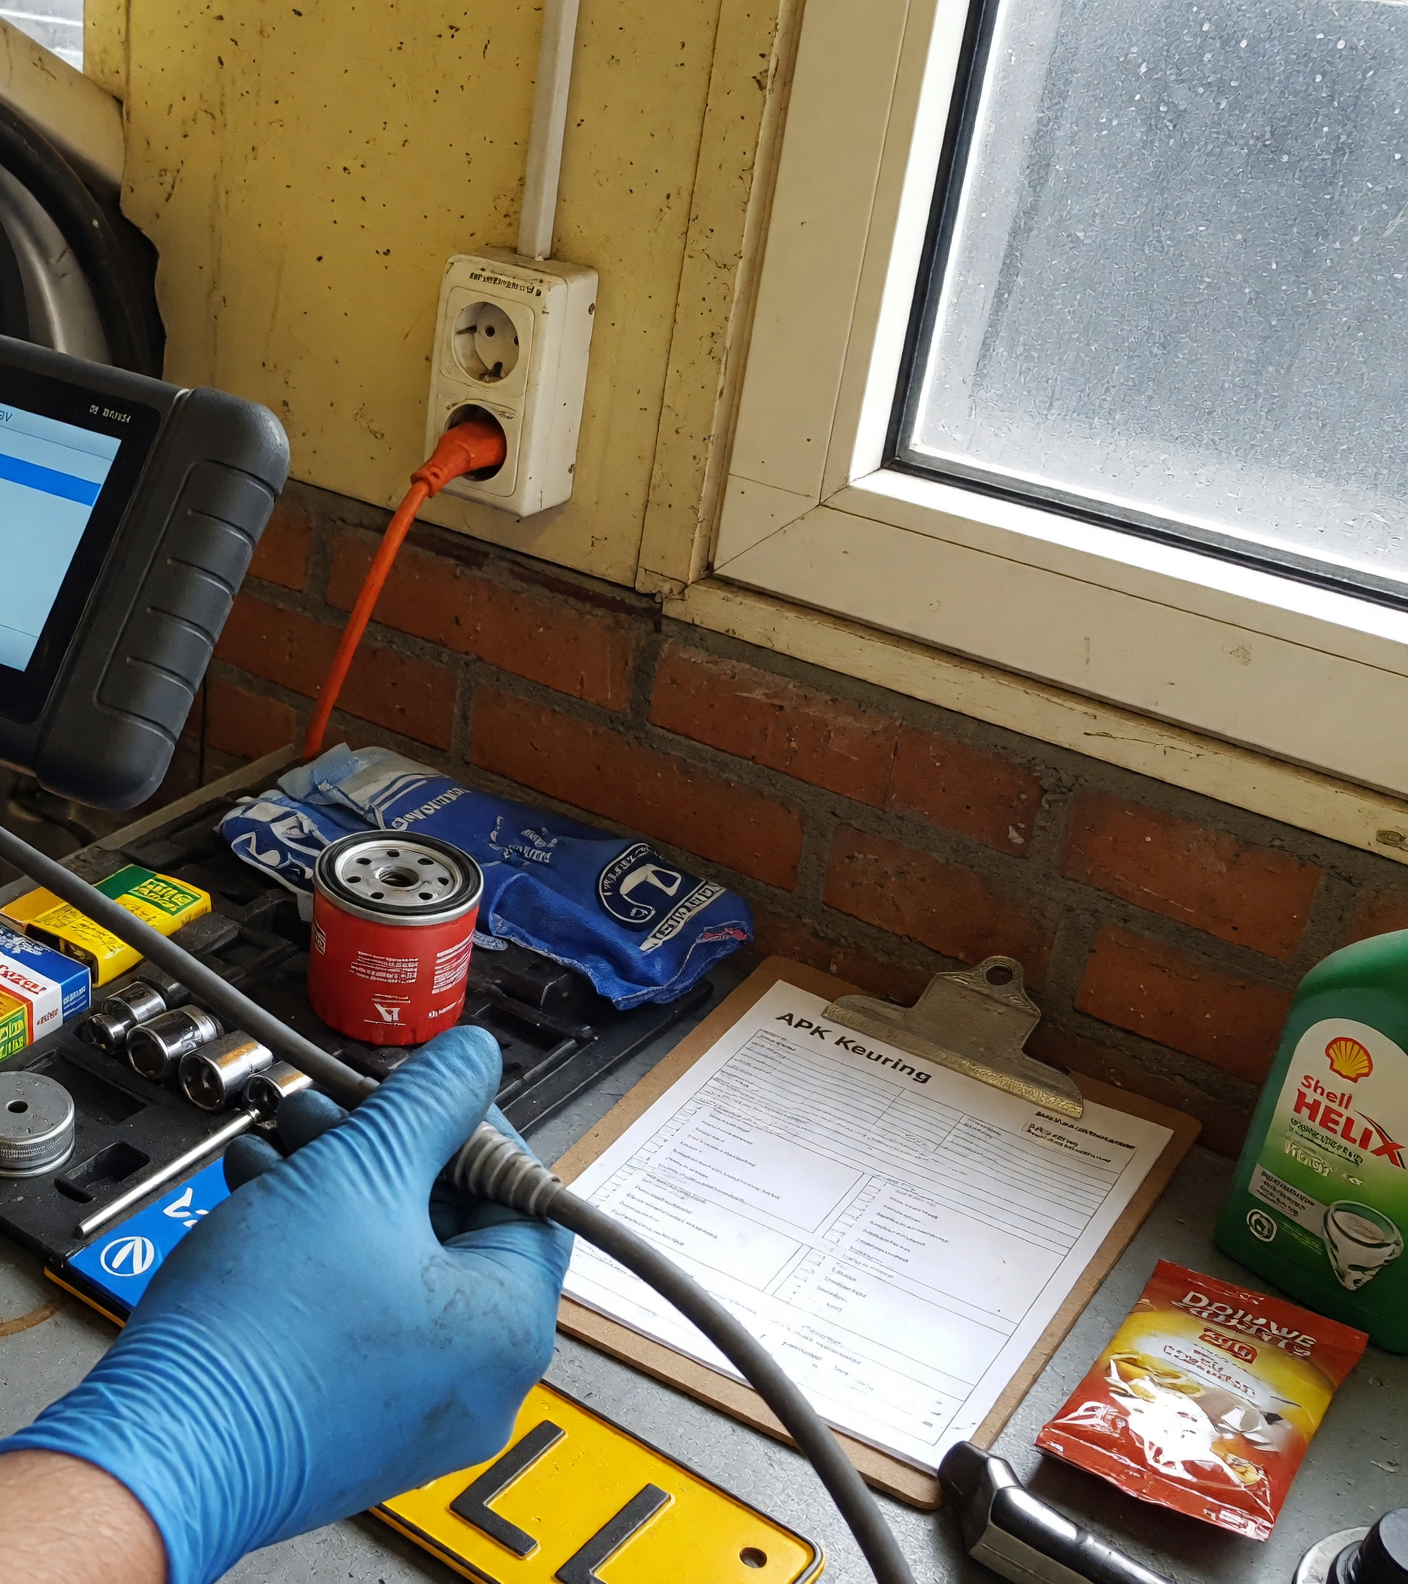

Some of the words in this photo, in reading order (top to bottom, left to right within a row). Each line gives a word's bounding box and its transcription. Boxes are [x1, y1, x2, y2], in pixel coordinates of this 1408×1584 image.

[775, 1012, 833, 1041] APK
[833, 1035, 933, 1085] Keuring
[1300, 1073, 1354, 1111] Shell
[1292, 1087, 1407, 1171] HELIX
